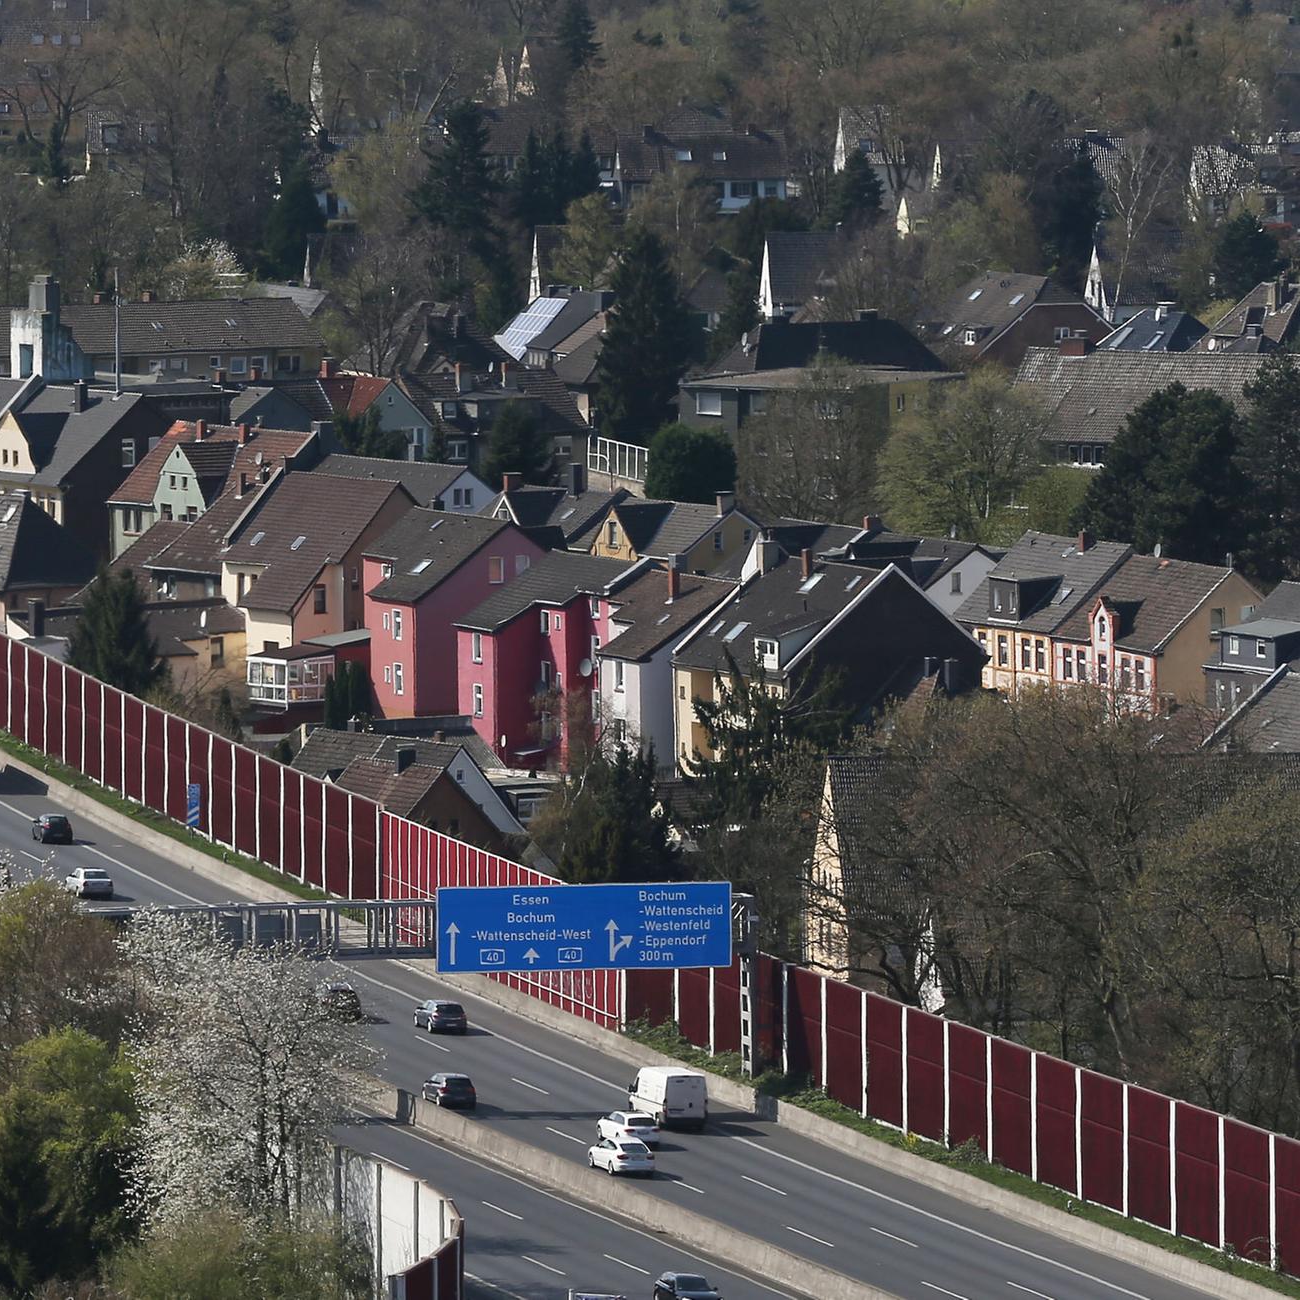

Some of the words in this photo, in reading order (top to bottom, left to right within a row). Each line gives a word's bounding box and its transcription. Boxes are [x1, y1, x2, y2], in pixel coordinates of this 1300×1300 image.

[512, 894, 550, 906] Essen
[639, 889, 687, 902] Bochum
[639, 904, 724, 917] -Wattenscheid
[507, 911, 556, 924] Bochum
[639, 919, 711, 932] -Westenfeld
[471, 928, 591, 942] -Wattenscheid-West
[639, 934, 707, 948] -Eppendorf
[486, 952, 499, 962] 40
[564, 950, 577, 960] 40
[639, 950, 660, 962] 300
[662, 952, 674, 961] m
